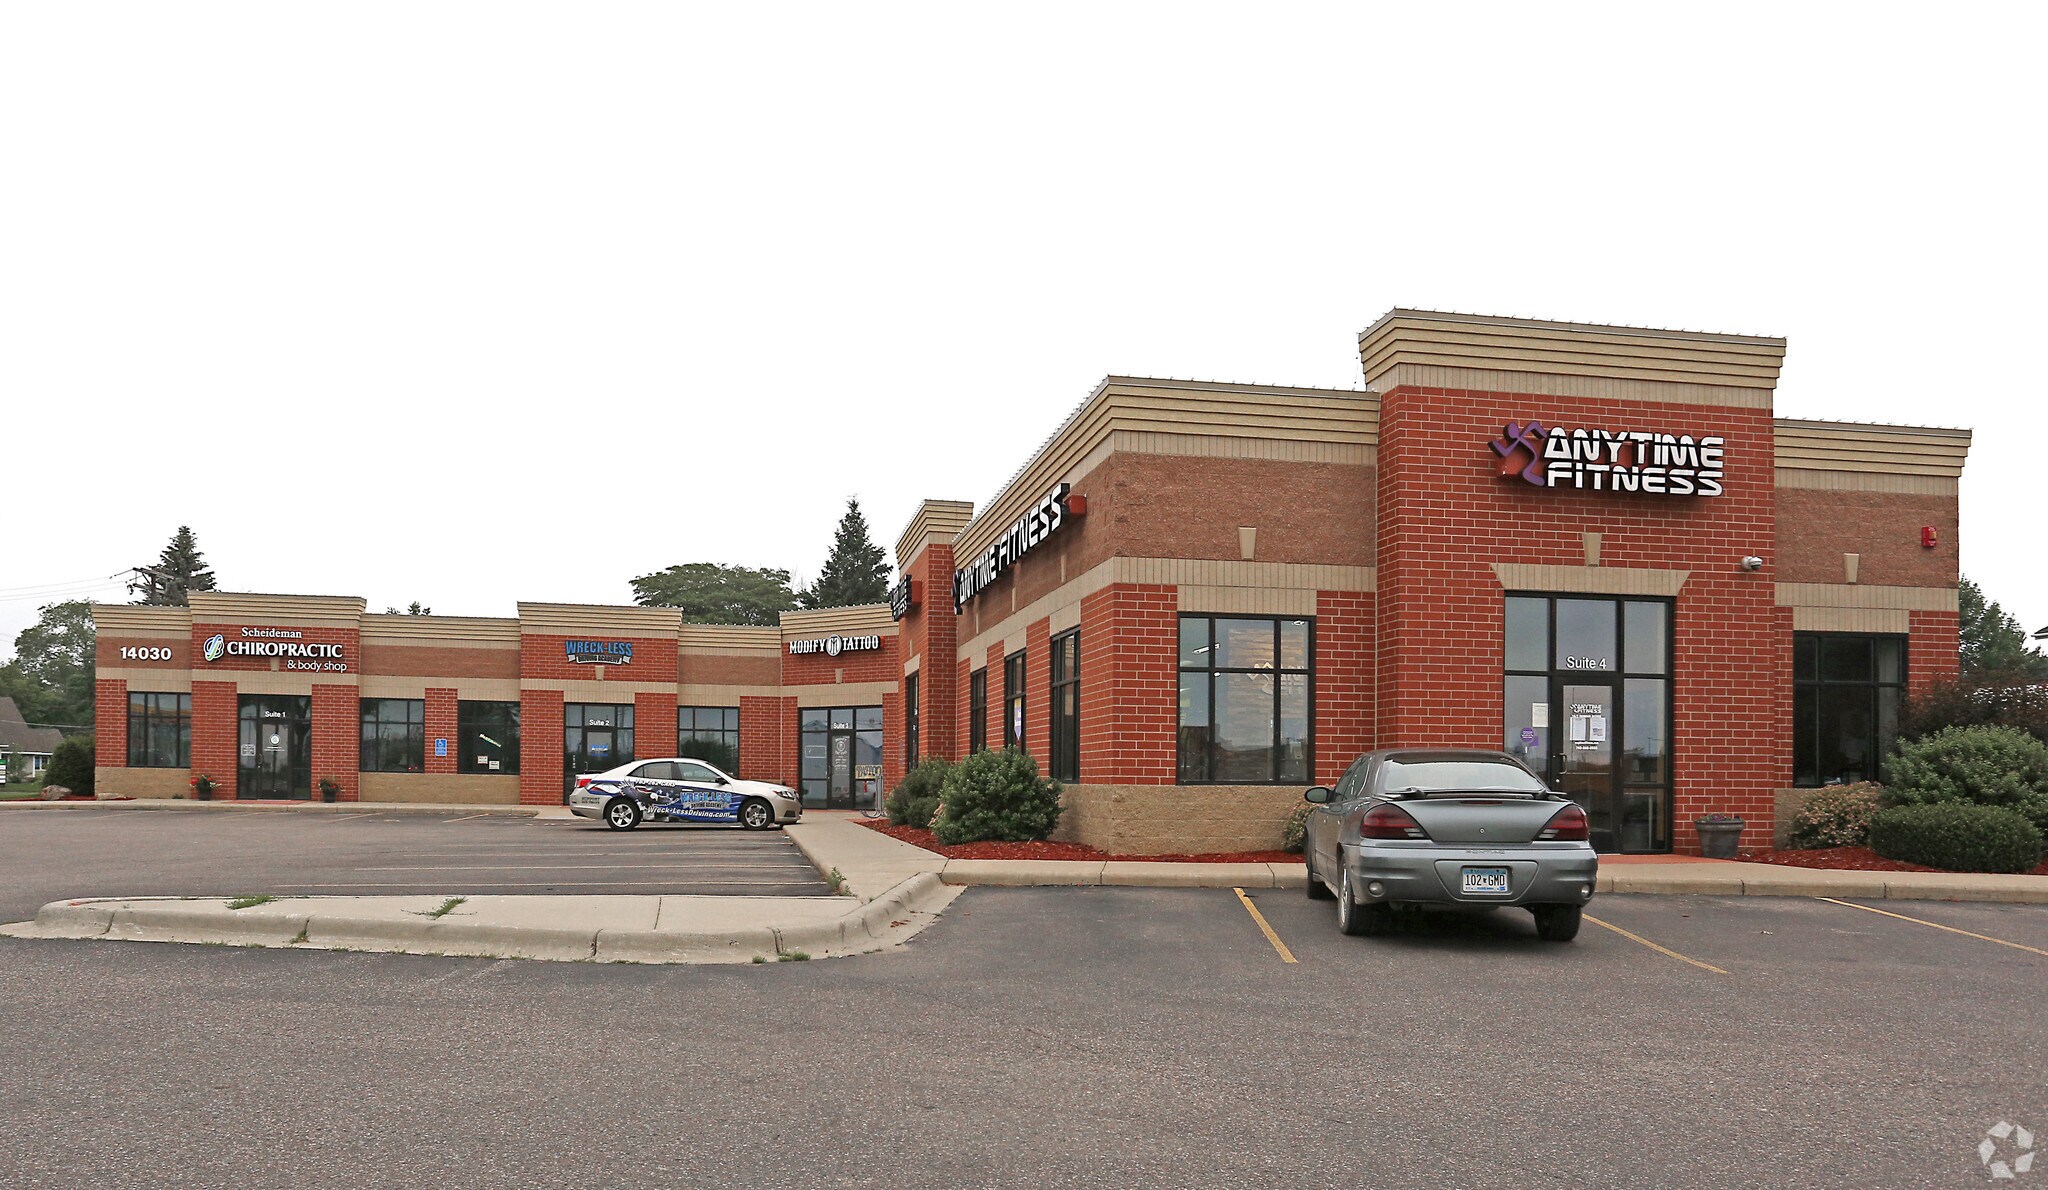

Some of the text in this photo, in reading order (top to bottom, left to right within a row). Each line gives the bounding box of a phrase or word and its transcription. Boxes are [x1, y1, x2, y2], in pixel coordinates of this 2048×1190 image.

[1544, 426, 1724, 469] ANYTIME
[1547, 461, 1724, 496] FITNESS
[959, 545, 998, 605] ANYTIME
[998, 483, 1064, 572] FITNESS
[241, 626, 302, 639] Scheideman
[226, 641, 343, 658] CHIROPRACTIC
[565, 640, 632, 656] WRECK-LESS
[788, 635, 879, 654] MODIFY TATTOO
[120, 646, 172, 660] 14030
[287, 659, 347, 673] & body shop
[1566, 655, 1607, 669] Suite 4
[680, 792, 732, 803] WRECK-LESS
[647, 805, 731, 818] Wreck-LessDriving.com
[1465, 874, 1482, 886] 102
